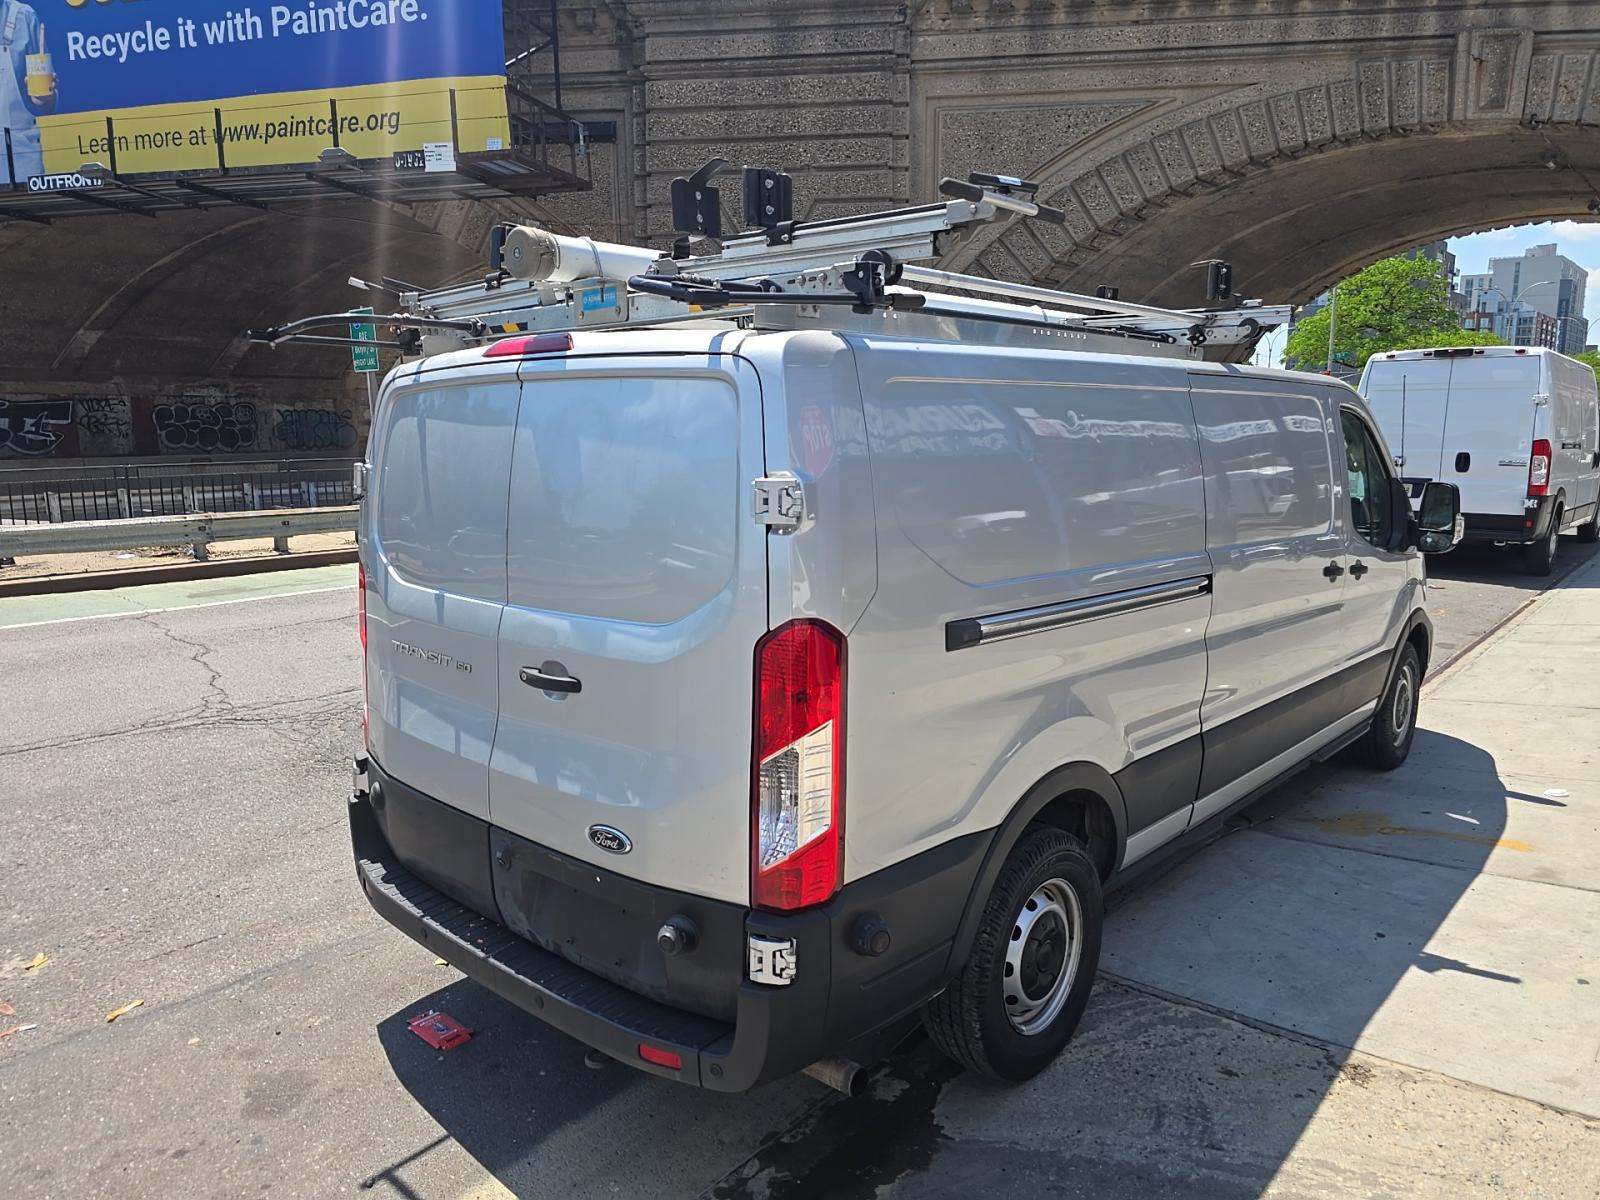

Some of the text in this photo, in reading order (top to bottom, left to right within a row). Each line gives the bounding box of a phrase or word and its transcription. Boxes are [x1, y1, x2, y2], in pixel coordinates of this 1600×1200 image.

[67, 0, 427, 63] Recycle it with PaintCare.
[135, 130, 182, 150] more
[188, 126, 207, 145] at
[391, 640, 452, 666] TRANSIT
[594, 831, 619, 849] Ford
